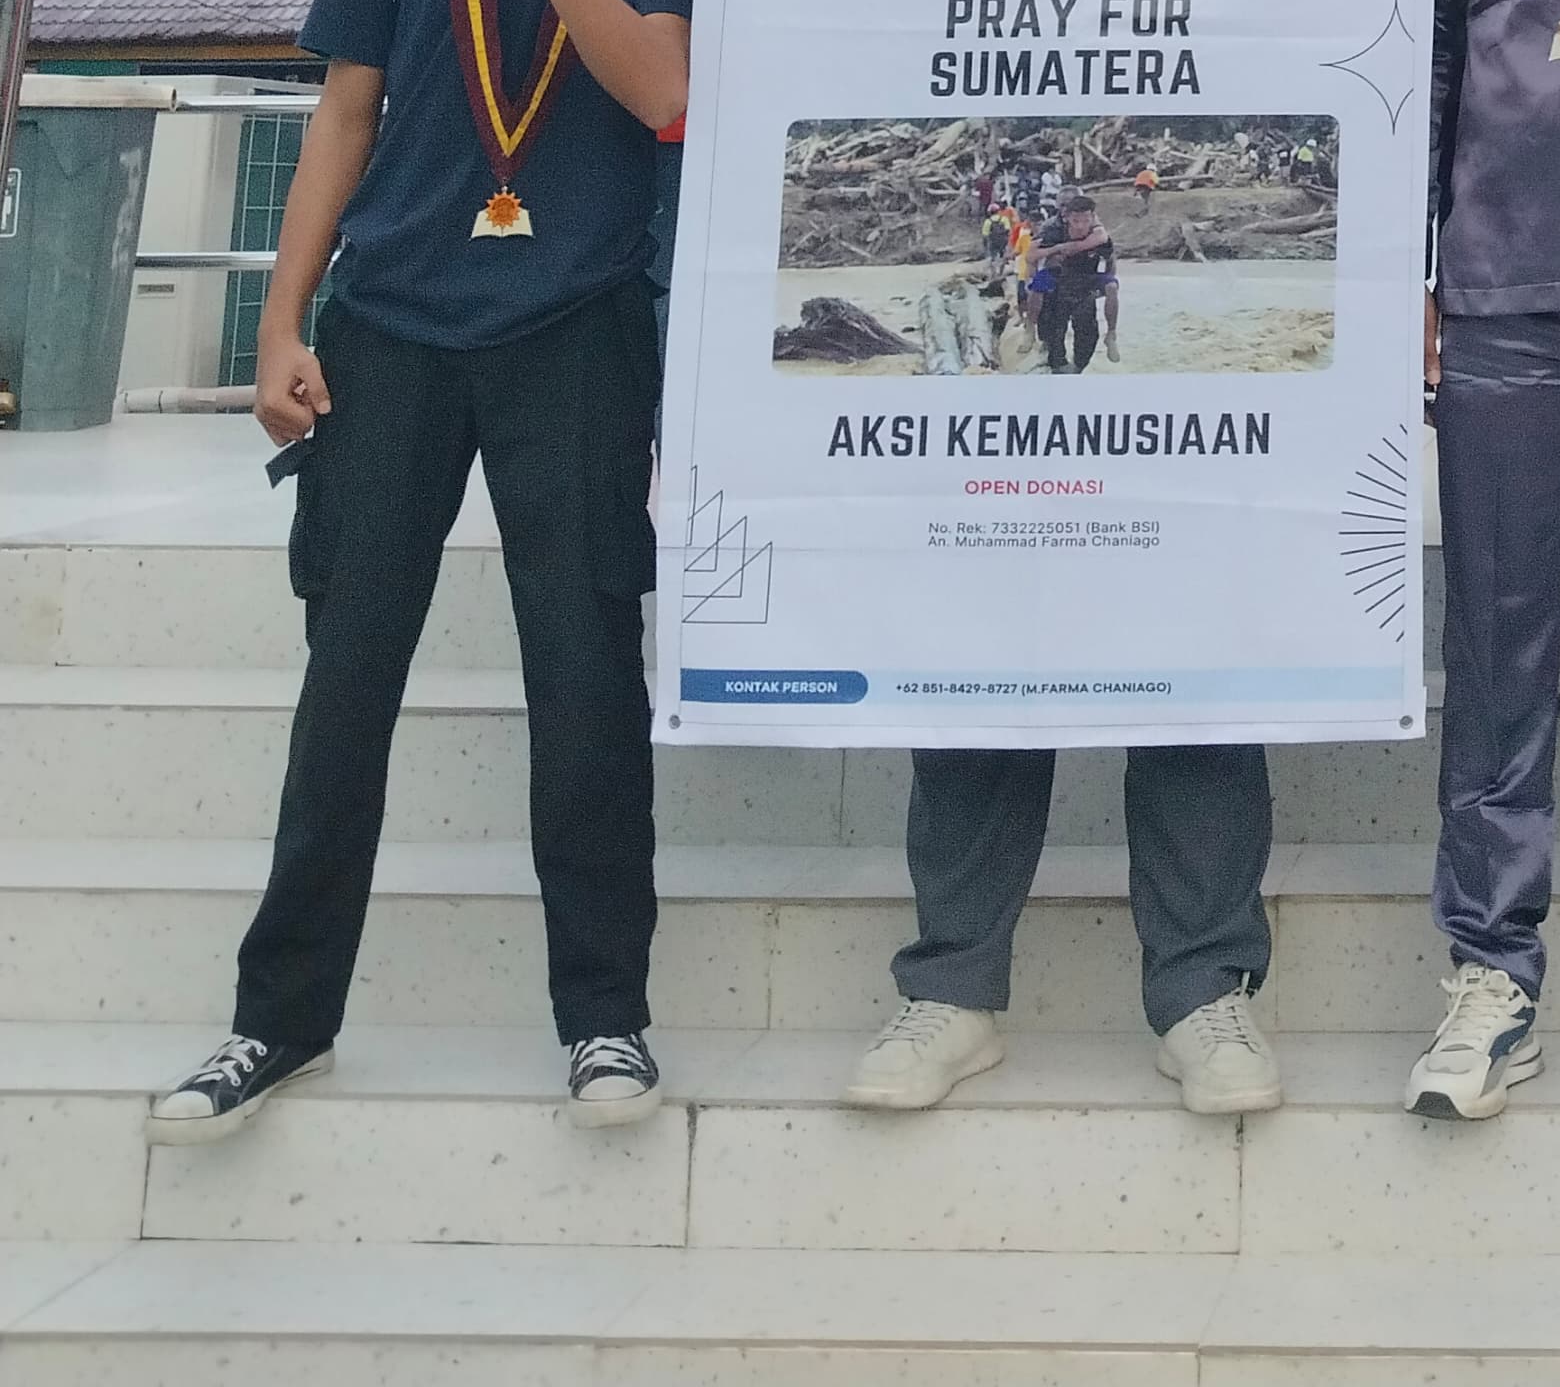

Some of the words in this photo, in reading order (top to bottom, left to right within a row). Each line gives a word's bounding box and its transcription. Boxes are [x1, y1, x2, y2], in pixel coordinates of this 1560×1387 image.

[931, 50, 1200, 96] SUMATERA
[828, 416, 928, 456] AKSI
[947, 413, 1270, 456] KEMANUSIAAN
[965, 481, 1019, 494] OPEN
[1027, 480, 1103, 494] DONASI
[957, 523, 986, 533] Rek:
[992, 522, 1079, 534] 7332225051
[1086, 522, 1126, 534] (Bank
[1132, 521, 1159, 534] BSI)
[955, 536, 1036, 547] Muhammad
[1042, 536, 1086, 547] Farma
[1092, 535, 1159, 548] Chaniago
[726, 682, 778, 692] KONTAK
[783, 682, 837, 692] PERSON
[897, 683, 918, 692] +62
[922, 683, 1017, 693] 851-8429-8727
[1093, 683, 1171, 694] CHANIAGO)
